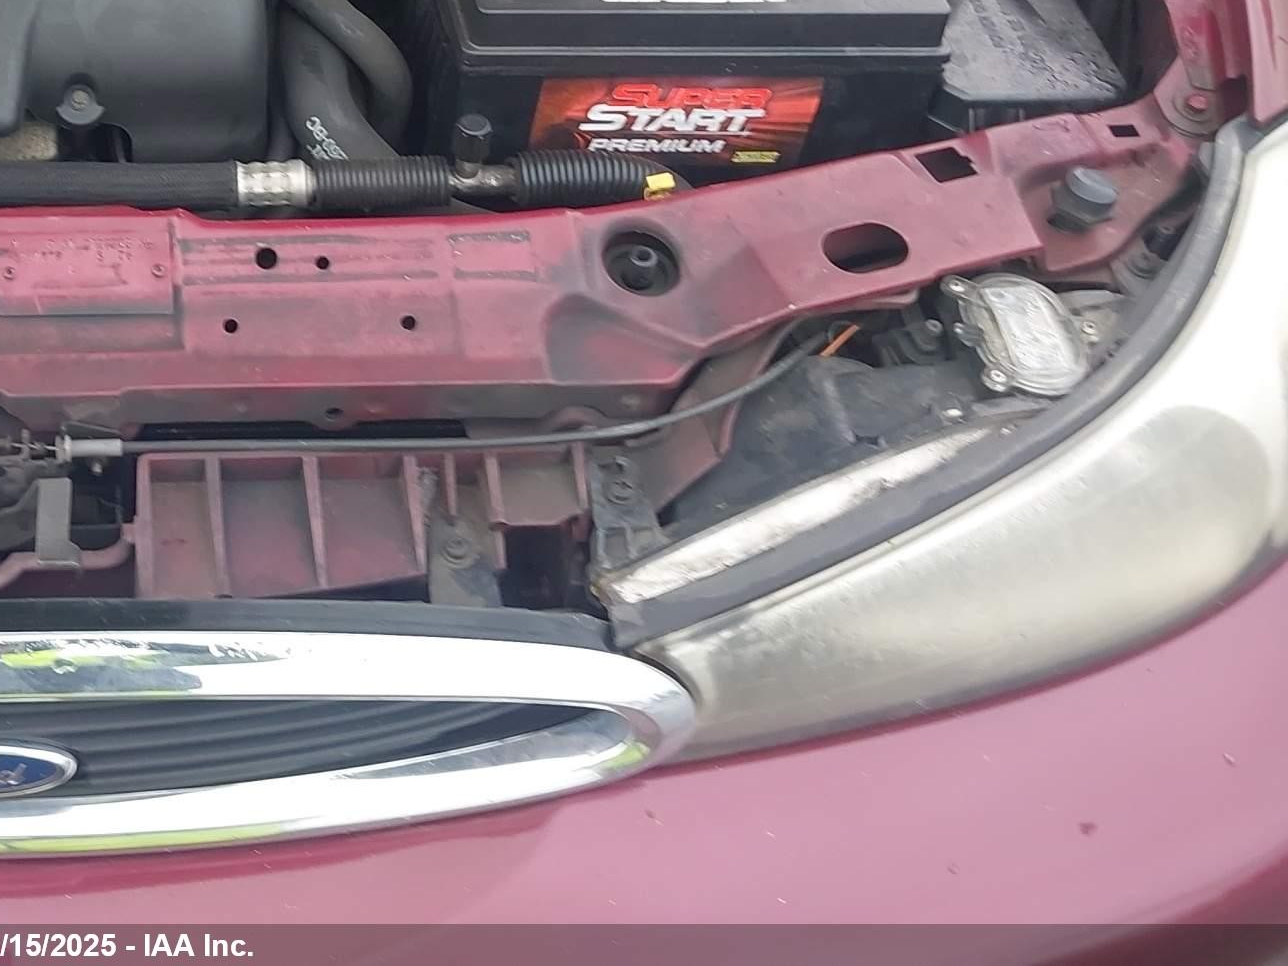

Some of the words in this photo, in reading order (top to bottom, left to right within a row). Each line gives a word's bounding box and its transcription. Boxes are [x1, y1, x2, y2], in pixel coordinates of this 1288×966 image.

[609, 83, 772, 109] SUPER
[578, 104, 766, 132] START
[587, 138, 727, 153] PREMIUM
